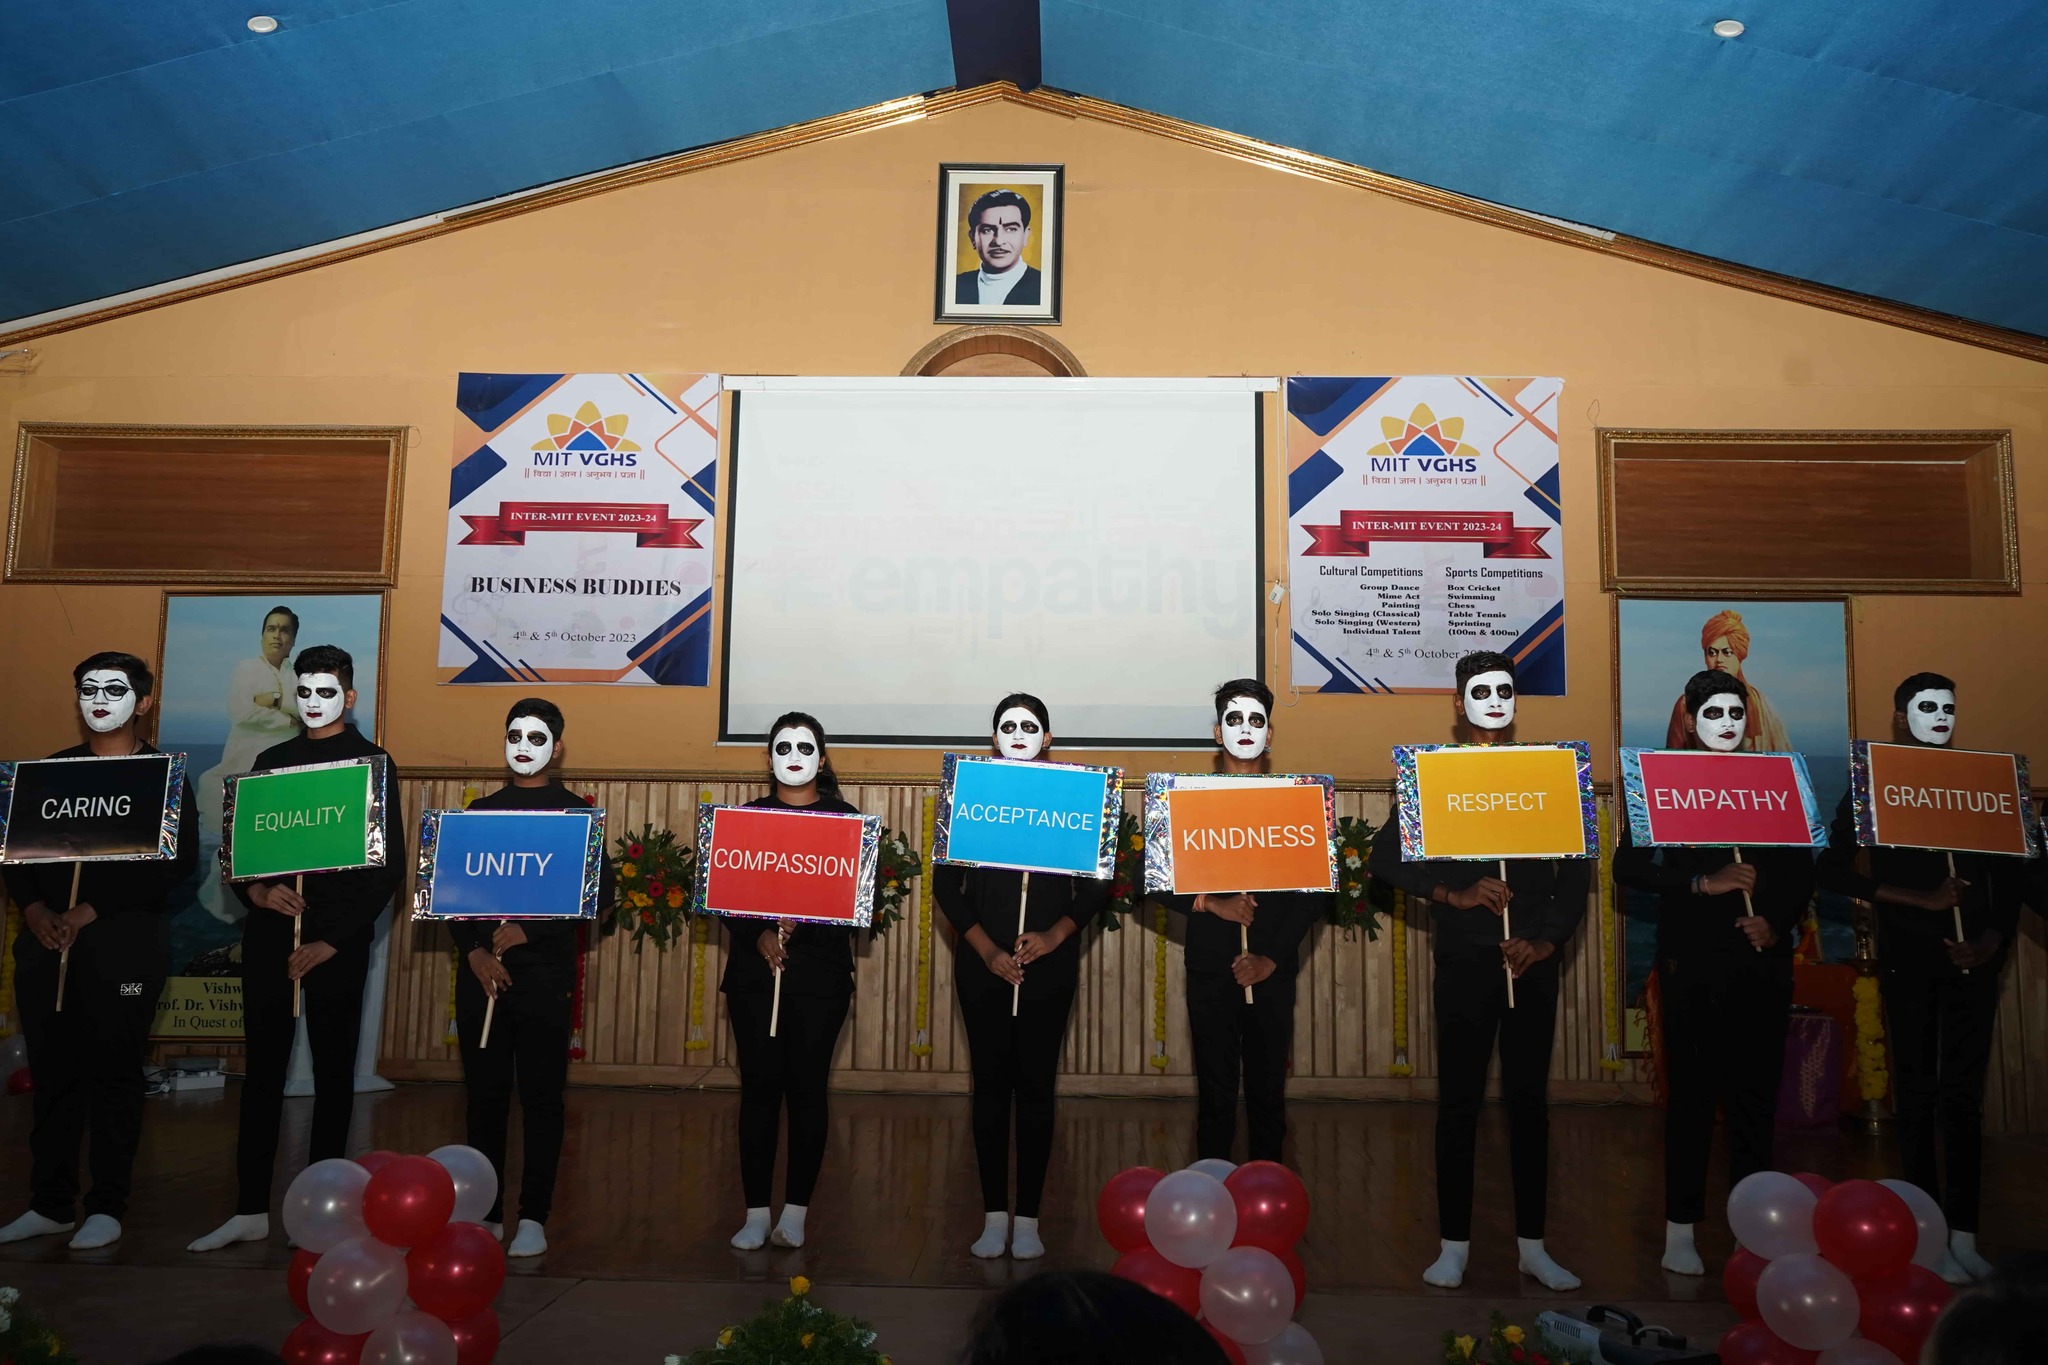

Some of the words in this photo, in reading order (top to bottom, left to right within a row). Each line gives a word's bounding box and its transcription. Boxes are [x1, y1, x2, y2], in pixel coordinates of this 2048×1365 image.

[534, 453, 572, 466] MIT
[580, 453, 637, 466] VGHS
[1372, 458, 1410, 471] MIT
[1418, 459, 1477, 472] VGHS
[510, 512, 574, 521] INTER-MIT
[576, 512, 616, 521] EVENT
[618, 513, 657, 522] 2023-24
[1352, 521, 1418, 530] INTER-MIT
[1420, 522, 1459, 531] EVENT
[1463, 522, 1502, 531] 2023-24
[1320, 565, 1358, 576] Cultural
[1361, 566, 1423, 578] Competitions
[1446, 567, 1478, 579] Sports
[1481, 568, 1543, 580] Competitions
[470, 577, 577, 594] BUSINESS
[582, 578, 682, 596] BUDDIES
[1360, 584, 1390, 592] Group
[1448, 594, 1495, 602] Swimming
[1382, 602, 1420, 610] Painting
[1335, 610, 1370, 618] Singing
[1372, 610, 1421, 618] (Classical)
[1338, 619, 1374, 627] Singing
[1376, 619, 1421, 627] (Western)
[1448, 620, 1491, 628] Sprinting
[513, 630, 527, 641] 4th
[530, 632, 540, 641] &
[544, 630, 558, 642] 5th
[561, 632, 606, 643] October
[609, 632, 636, 643] 2023
[1448, 629, 1477, 637] (100m
[1490, 629, 1520, 637] 400m)
[1383, 649, 1394, 659] &
[1414, 649, 1460, 660] October
[1447, 792, 1547, 812] RESPECT
[1654, 788, 1788, 811] EMPATHY
[1884, 785, 2013, 815] GRATITUDE
[41, 796, 131, 820] CARING
[254, 805, 346, 832] EQUALITY
[956, 803, 1094, 831] ACCEPTANCE
[1183, 825, 1316, 851] KINDNESS
[465, 852, 553, 877] UNITY
[714, 848, 855, 878] COMPASSION
[185, 999, 204, 1010] Dr.
[173, 1016, 186, 1027] In
[190, 1016, 225, 1030] Quest
